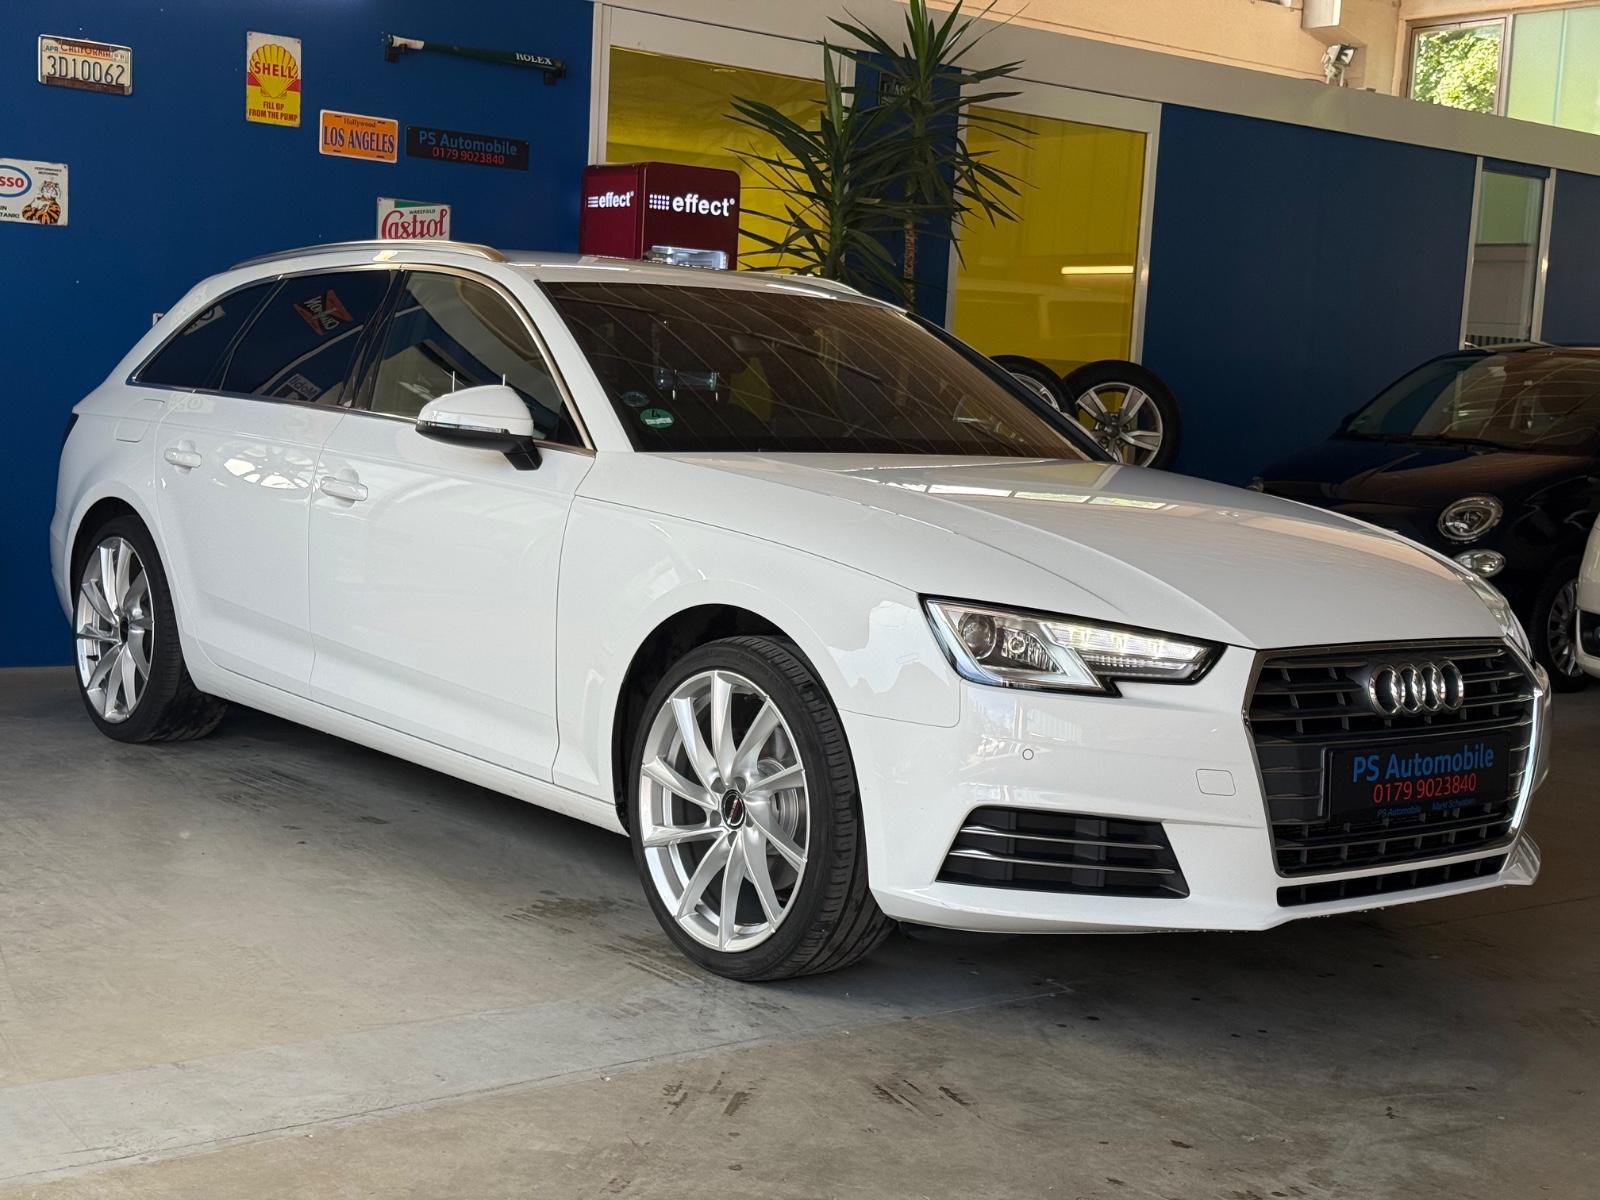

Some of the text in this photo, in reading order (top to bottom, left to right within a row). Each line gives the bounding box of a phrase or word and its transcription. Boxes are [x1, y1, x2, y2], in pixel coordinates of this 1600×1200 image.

[515, 52, 552, 65] ROLEX
[47, 55, 125, 86] 3D10062
[254, 61, 295, 79] SHELL
[249, 108, 298, 122] FROM THE PUMP
[263, 101, 275, 110] FILL
[344, 117, 376, 128] Hollywood
[324, 126, 395, 154] LOS ANGELES
[419, 131, 518, 156] PS Automobile
[432, 146, 505, 166] 0179 9023840
[381, 208, 448, 240] Castrol
[1353, 743, 1495, 783] PS Automobile
[1373, 773, 1478, 804] 0179 9023840
